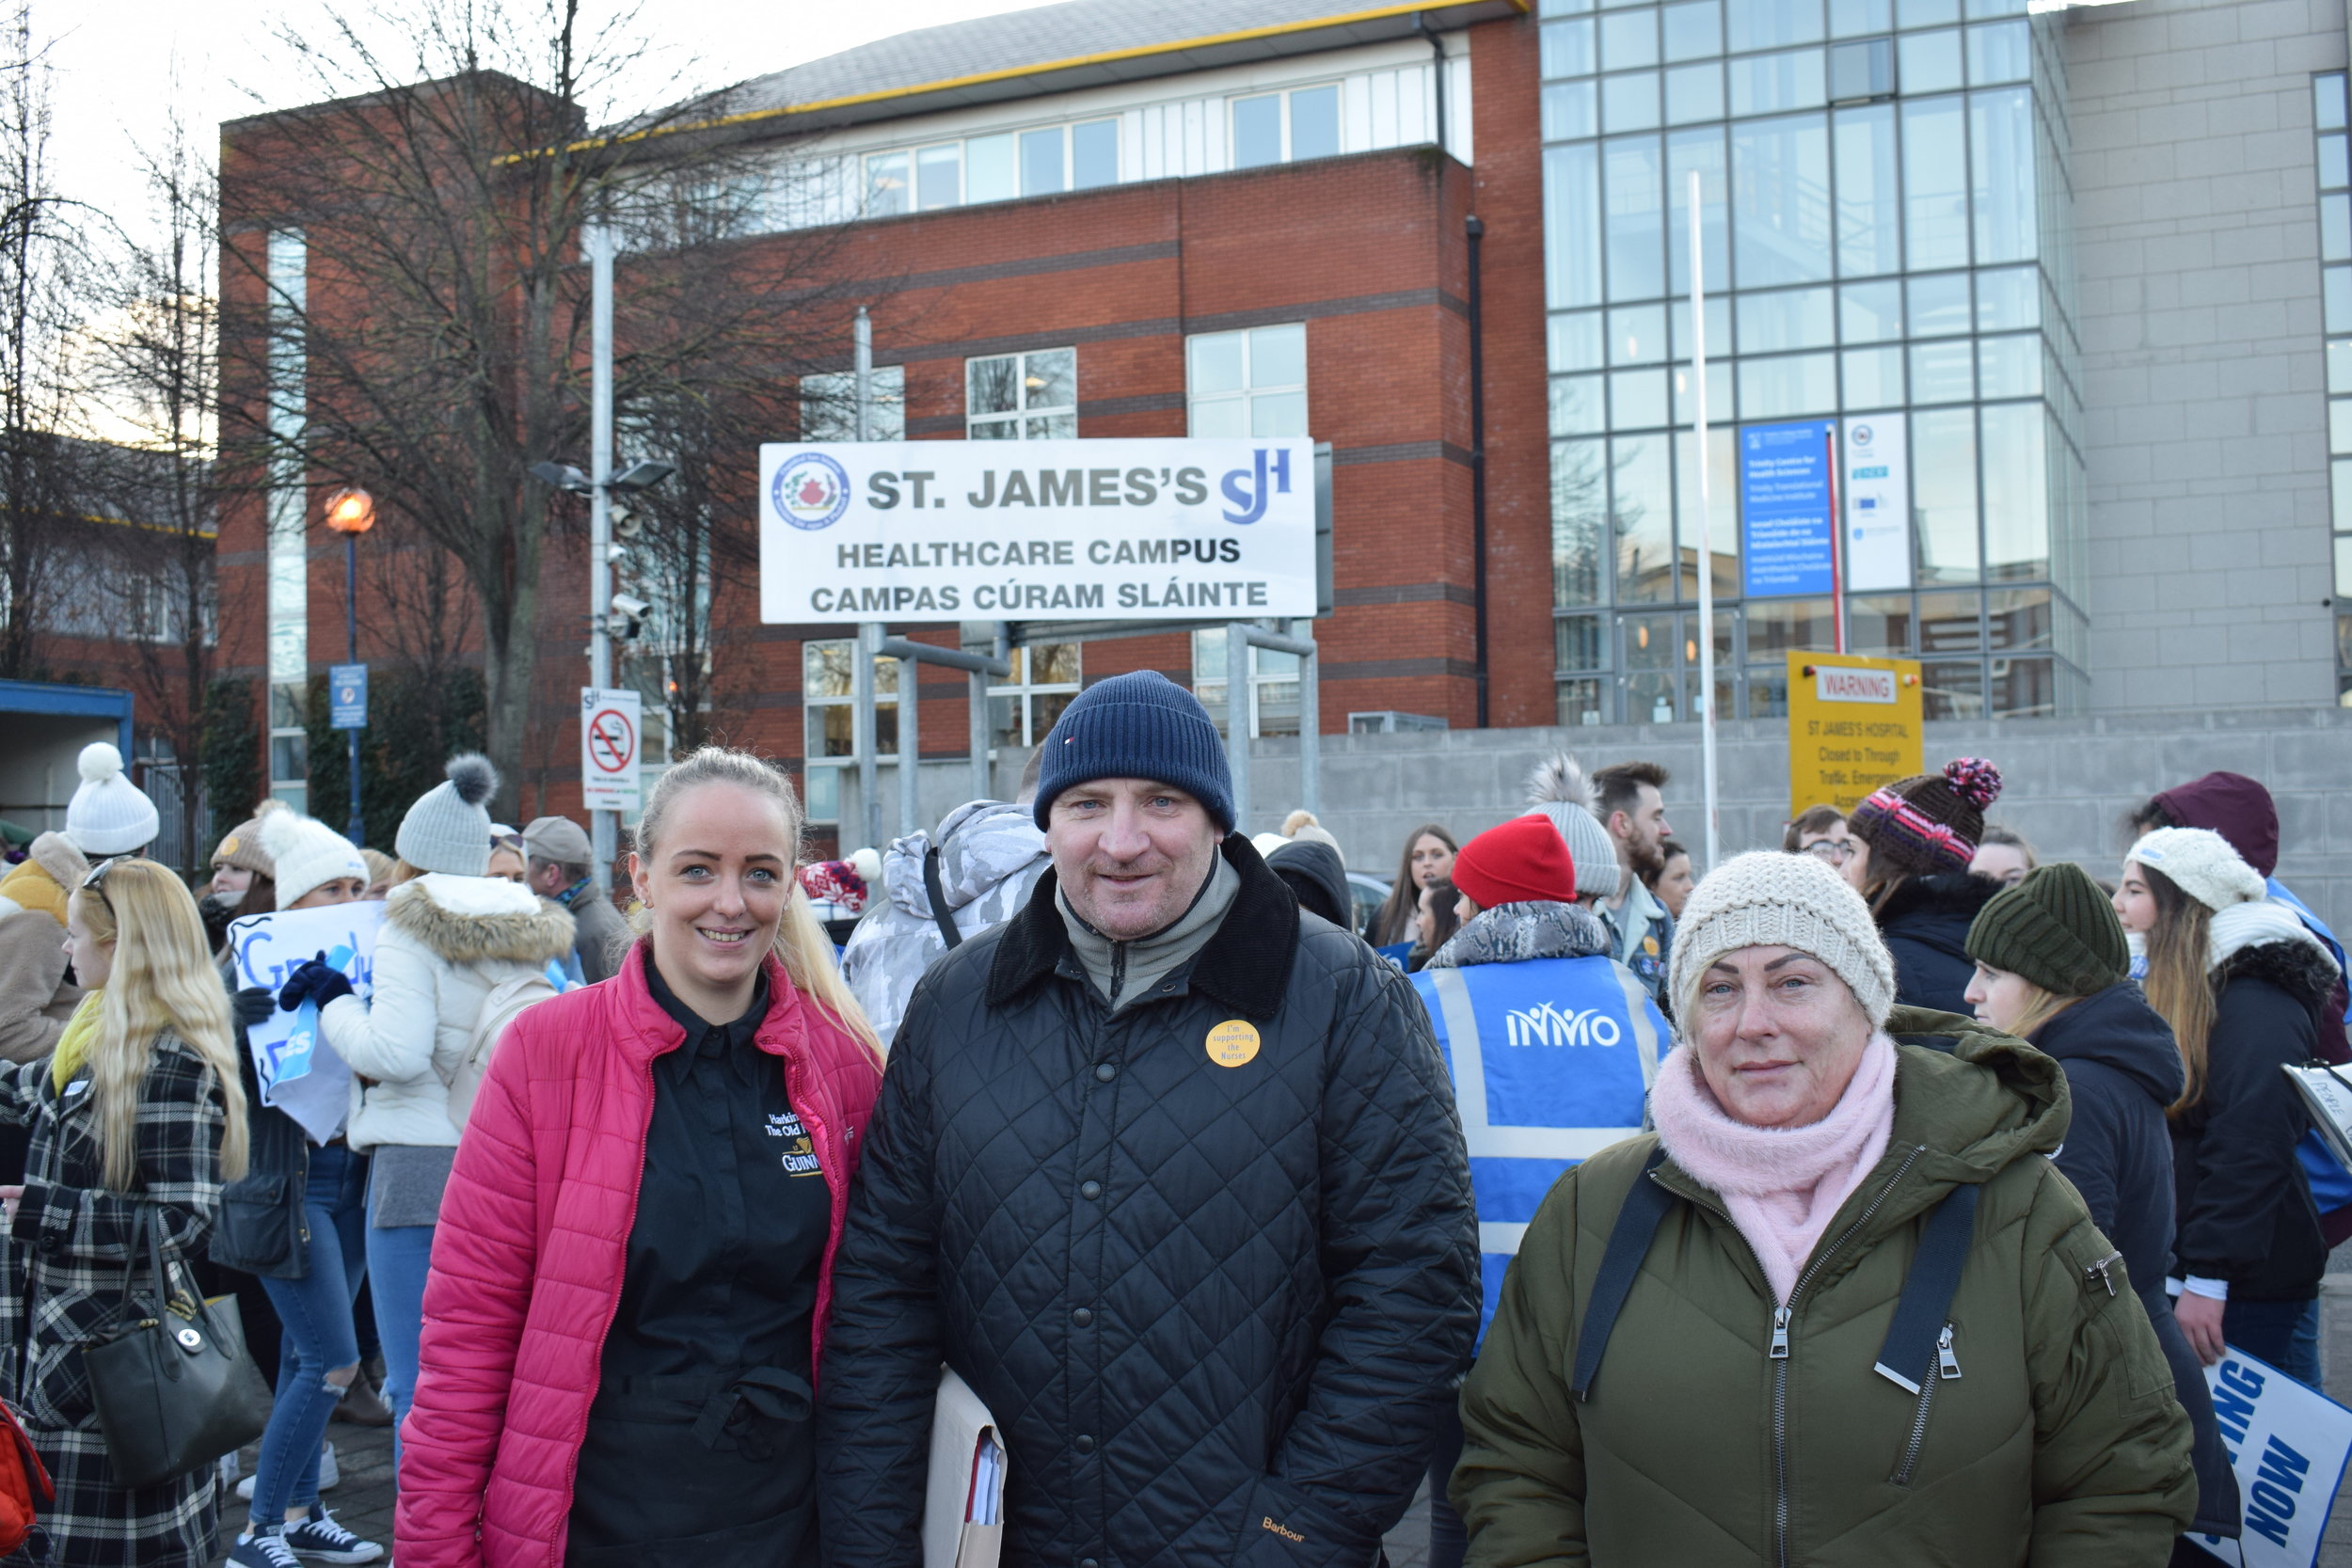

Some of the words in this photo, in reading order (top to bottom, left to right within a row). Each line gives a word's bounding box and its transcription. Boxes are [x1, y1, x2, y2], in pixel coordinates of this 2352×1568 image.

[866, 470, 945, 510] ST.
[967, 467, 1208, 509] JAMES'S
[837, 540, 1074, 568] HEALTHCARE
[1088, 538, 1241, 564] CAMPUS
[810, 586, 961, 612] CAMPAS
[973, 578, 1104, 610] CÚRAM
[1117, 576, 1268, 608] SLÁINTE
[1824, 674, 1890, 698] WARNING
[1808, 720, 1820, 736] ST
[1866, 722, 1908, 738] HOSPITAL
[1819, 746, 1851, 763] Closed
[1852, 749, 1863, 763] to
[1864, 746, 1899, 766] Through
[1227, 1024, 1240, 1033] I'm
[1506, 1001, 1620, 1046] INMO
[1213, 1034, 1254, 1042] supporting
[1221, 1052, 1247, 1060] Nurses
[768, 1112, 799, 1124] Harkin
[765, 1124, 783, 1136] The
[782, 1123, 802, 1136] Old
[782, 1153, 820, 1172] GUINN
[2245, 1433, 2311, 1548] NOW
[1262, 1515, 1305, 1543] Barbour
